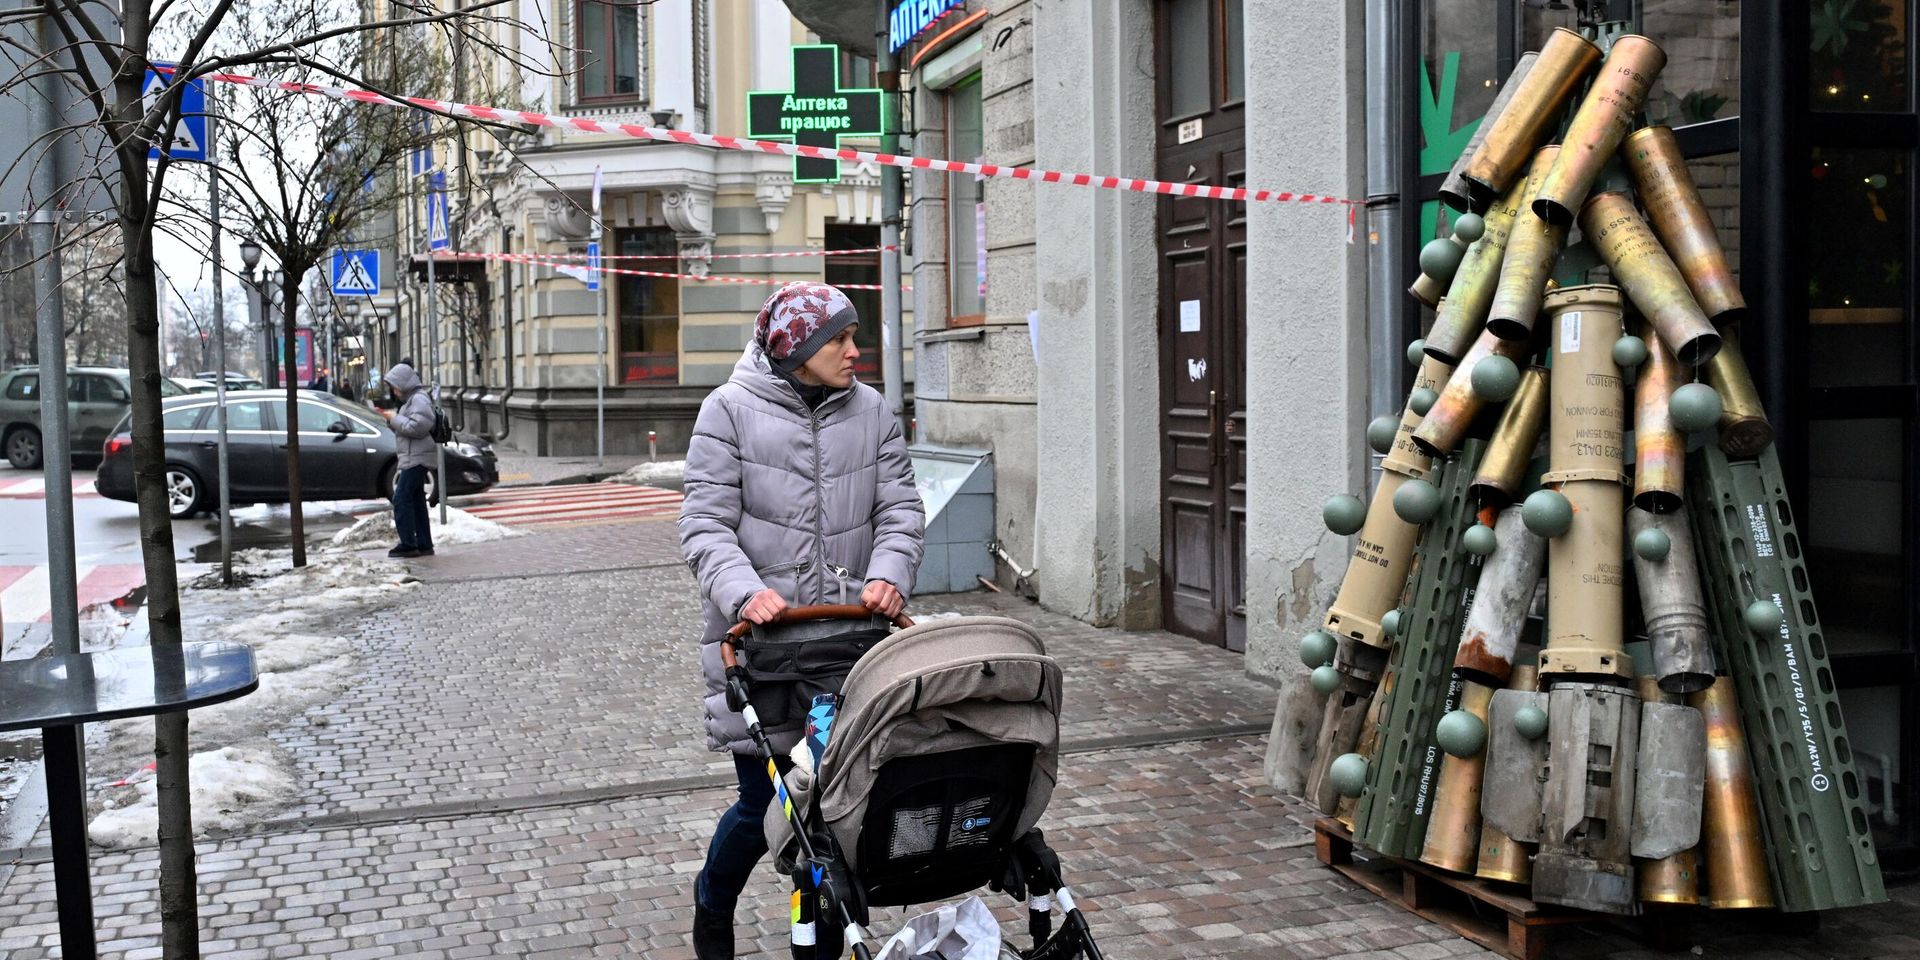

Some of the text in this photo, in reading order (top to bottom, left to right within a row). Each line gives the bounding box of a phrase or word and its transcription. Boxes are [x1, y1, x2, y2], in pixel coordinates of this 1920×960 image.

[889, 0, 962, 53] АПТЕК
[781, 95, 848, 111] Аптека
[780, 115, 850, 133] працює
[1565, 406, 1599, 417] CANNON
[1599, 407, 1613, 418] FOR
[1575, 429, 1602, 440] 155MM
[1371, 543, 1384, 554] CAN
[1367, 554, 1380, 564] NOT
[1379, 558, 1389, 568] DO
[1582, 573, 1601, 585] THIS
[1425, 745, 1437, 764] LOS
